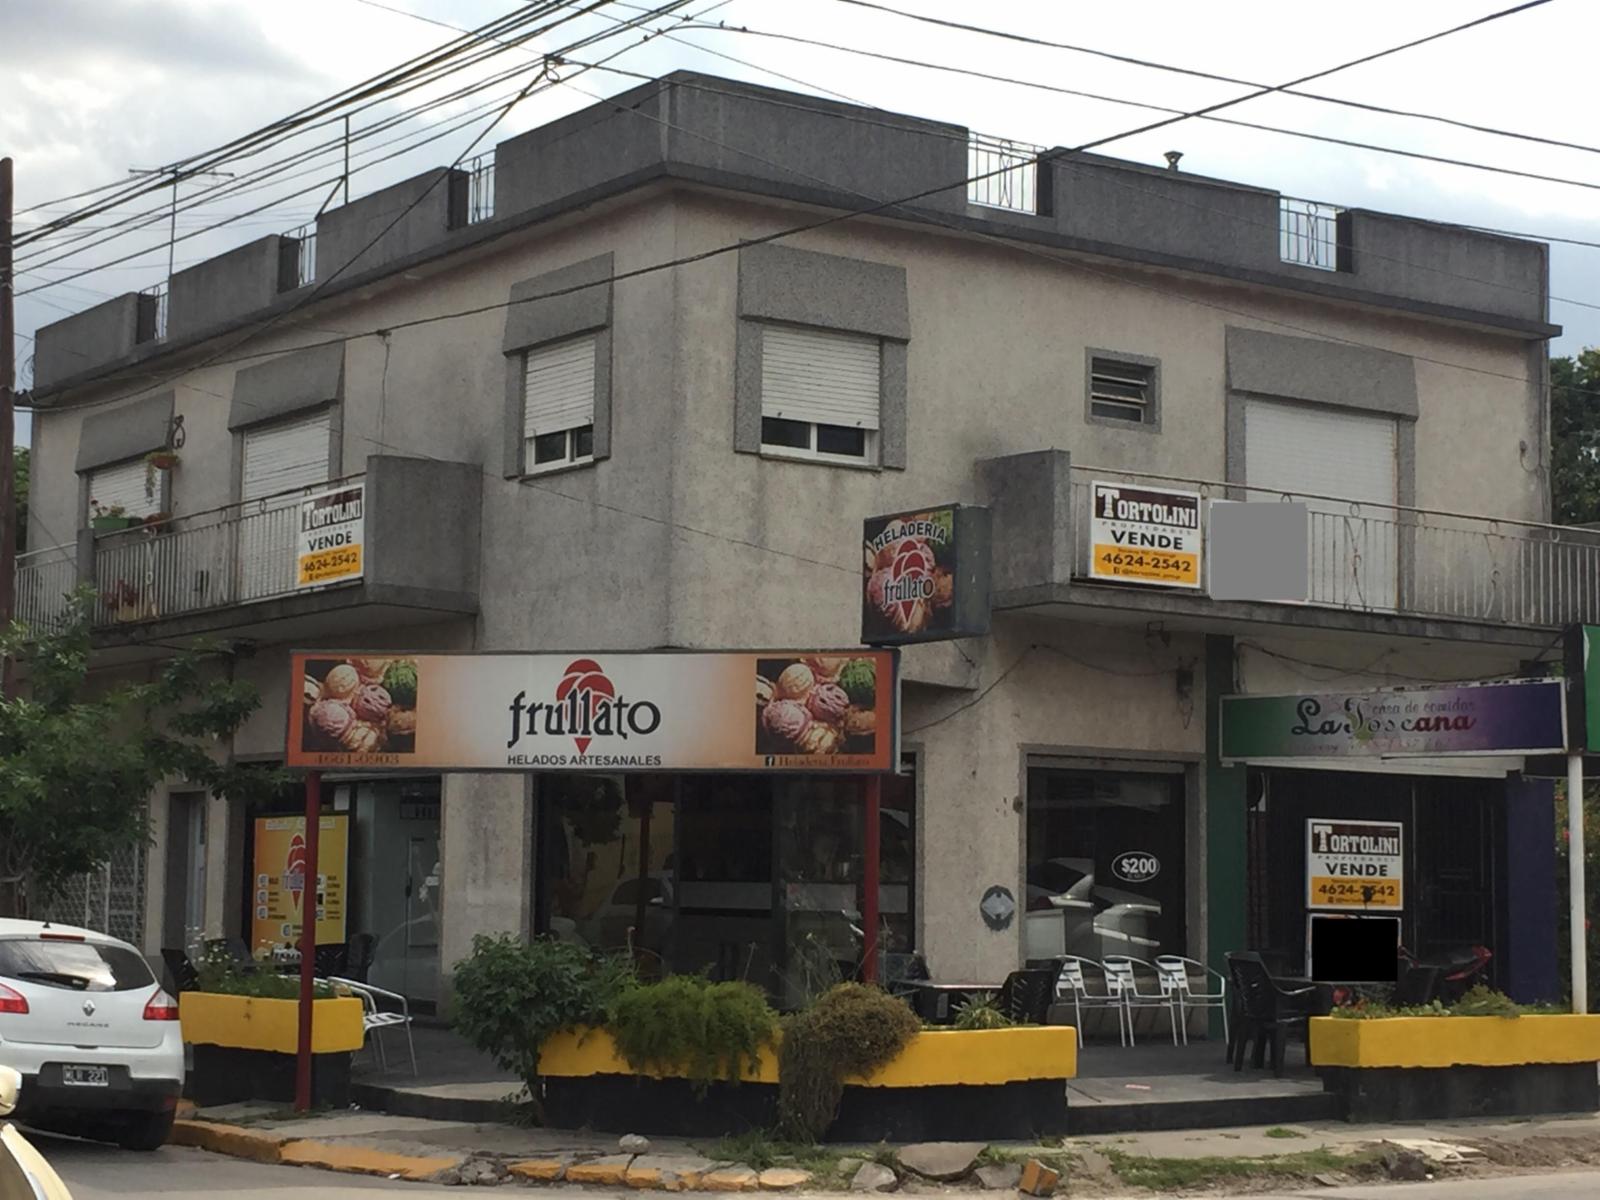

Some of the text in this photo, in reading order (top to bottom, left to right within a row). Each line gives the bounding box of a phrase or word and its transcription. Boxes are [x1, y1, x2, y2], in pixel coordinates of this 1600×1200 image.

[303, 499, 360, 530] TORTOLINI
[1097, 487, 1196, 527] TORTOLINI
[308, 531, 352, 552] VENDE
[873, 521, 947, 552] HELADERIA
[1111, 530, 1183, 550] VENDE
[304, 552, 358, 573] 4624-2542
[1102, 553, 1191, 572] 4624-2542
[883, 575, 934, 606] frullato
[1291, 698, 1343, 735] La
[1405, 699, 1418, 713] de
[507, 688, 661, 748] frullato
[507, 755, 662, 766] HELADOS ARTESANALES
[1313, 825, 1399, 854] TORTOLINI
[1121, 857, 1157, 873] $200
[1325, 862, 1388, 877] VENDE
